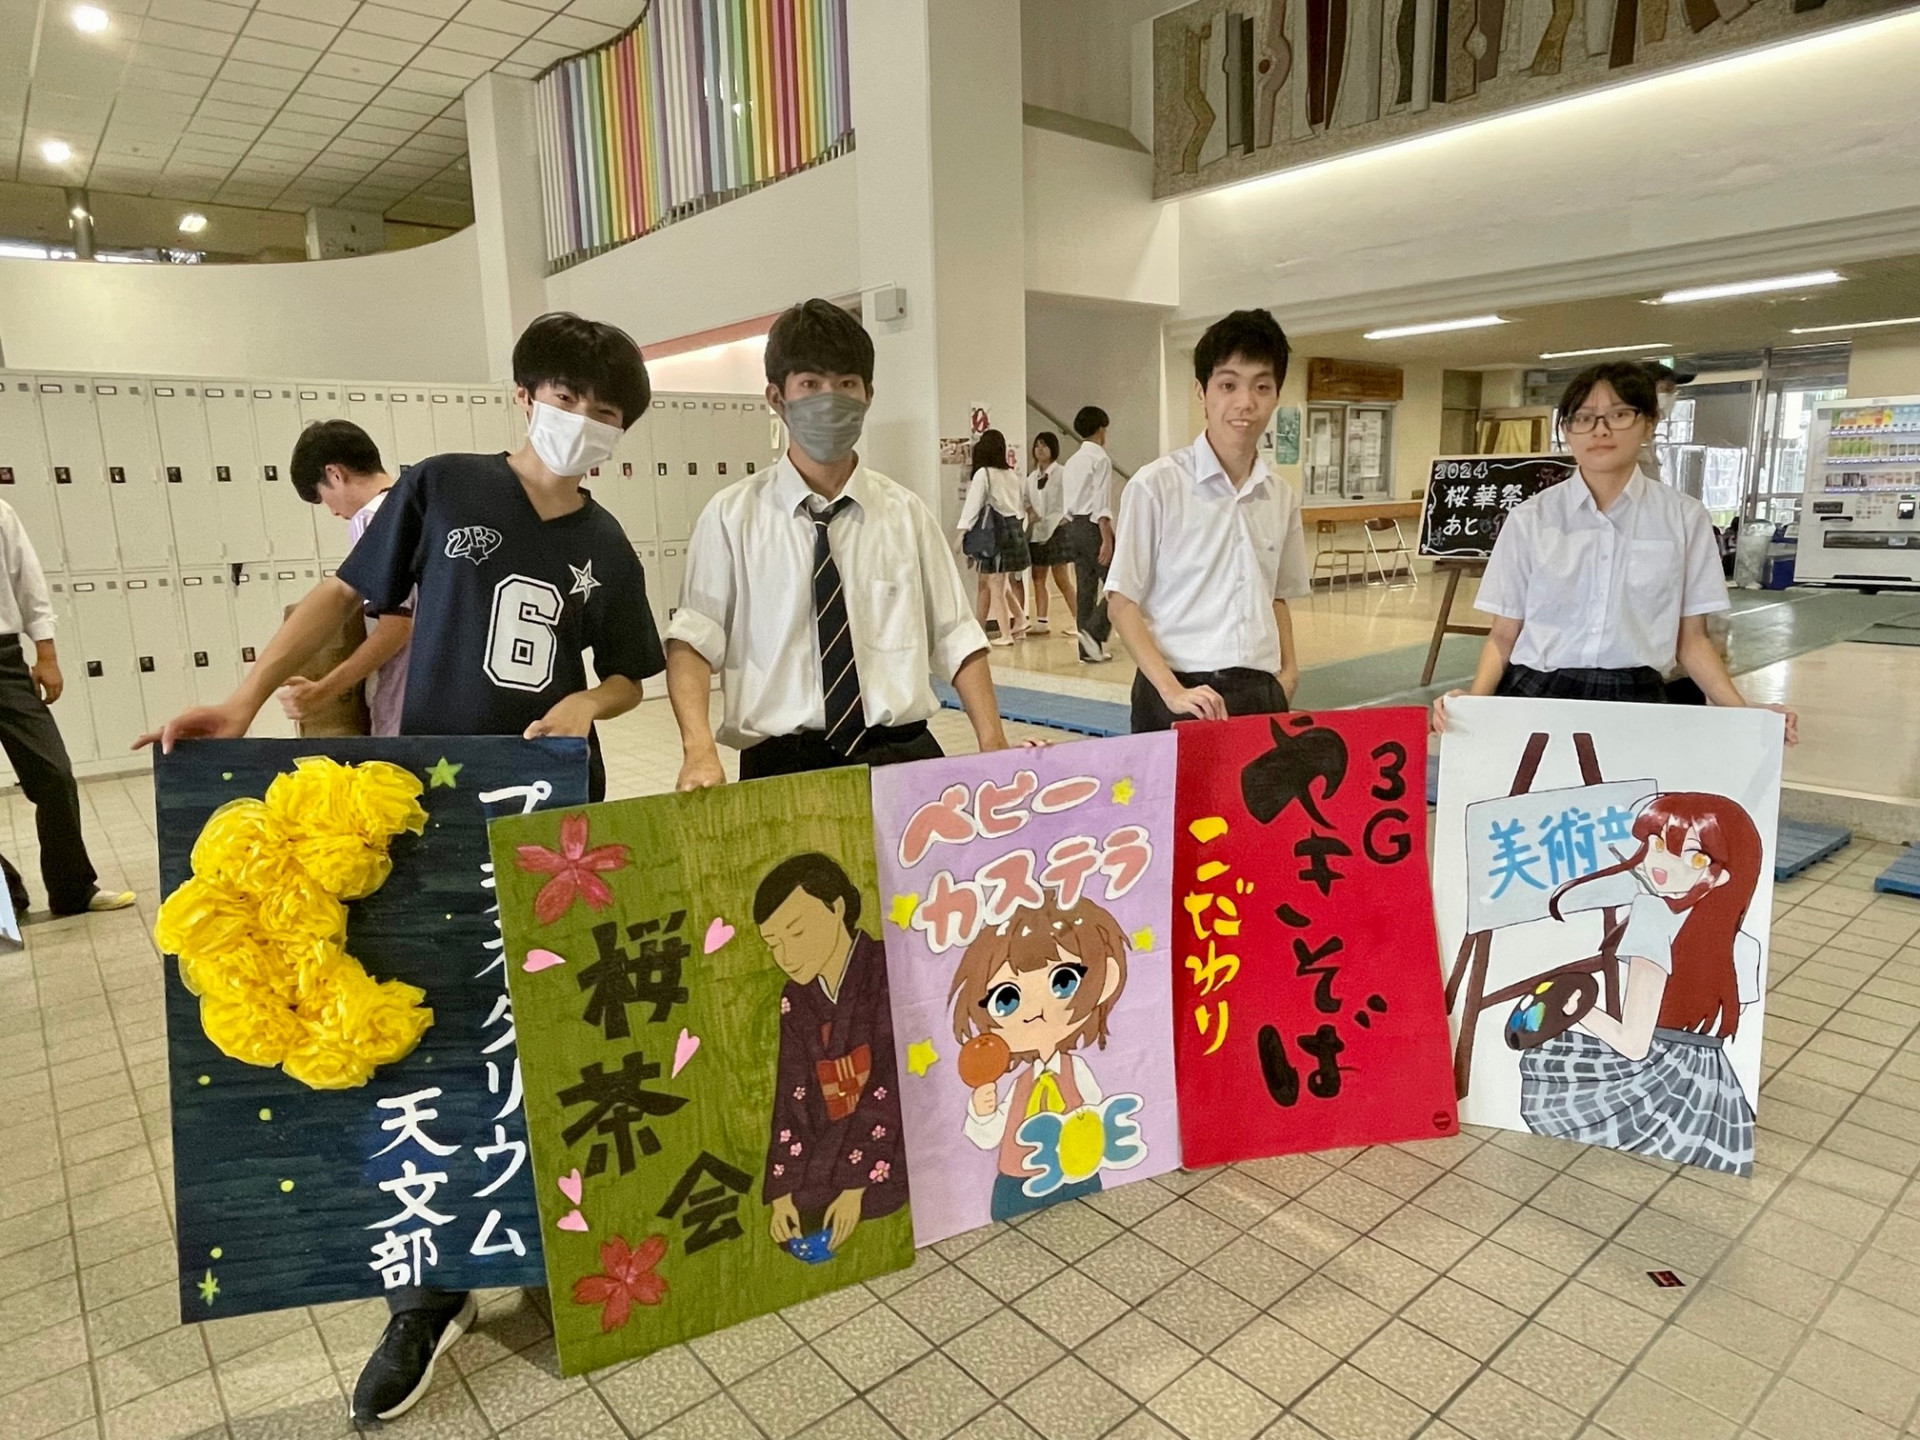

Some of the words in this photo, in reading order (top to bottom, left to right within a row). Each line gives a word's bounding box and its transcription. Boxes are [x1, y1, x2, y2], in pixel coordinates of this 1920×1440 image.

[1434, 461, 1489, 480] 2024
[1444, 484, 1538, 511] 桜華祭
[483, 573, 564, 693] 6
[898, 769, 1101, 869] ベビー
[910, 825, 1153, 955] カステラ
[1184, 816, 1255, 1057] こだわり
[1241, 715, 1388, 1108] やきそば
[364, 1086, 462, 1290] 天文部
